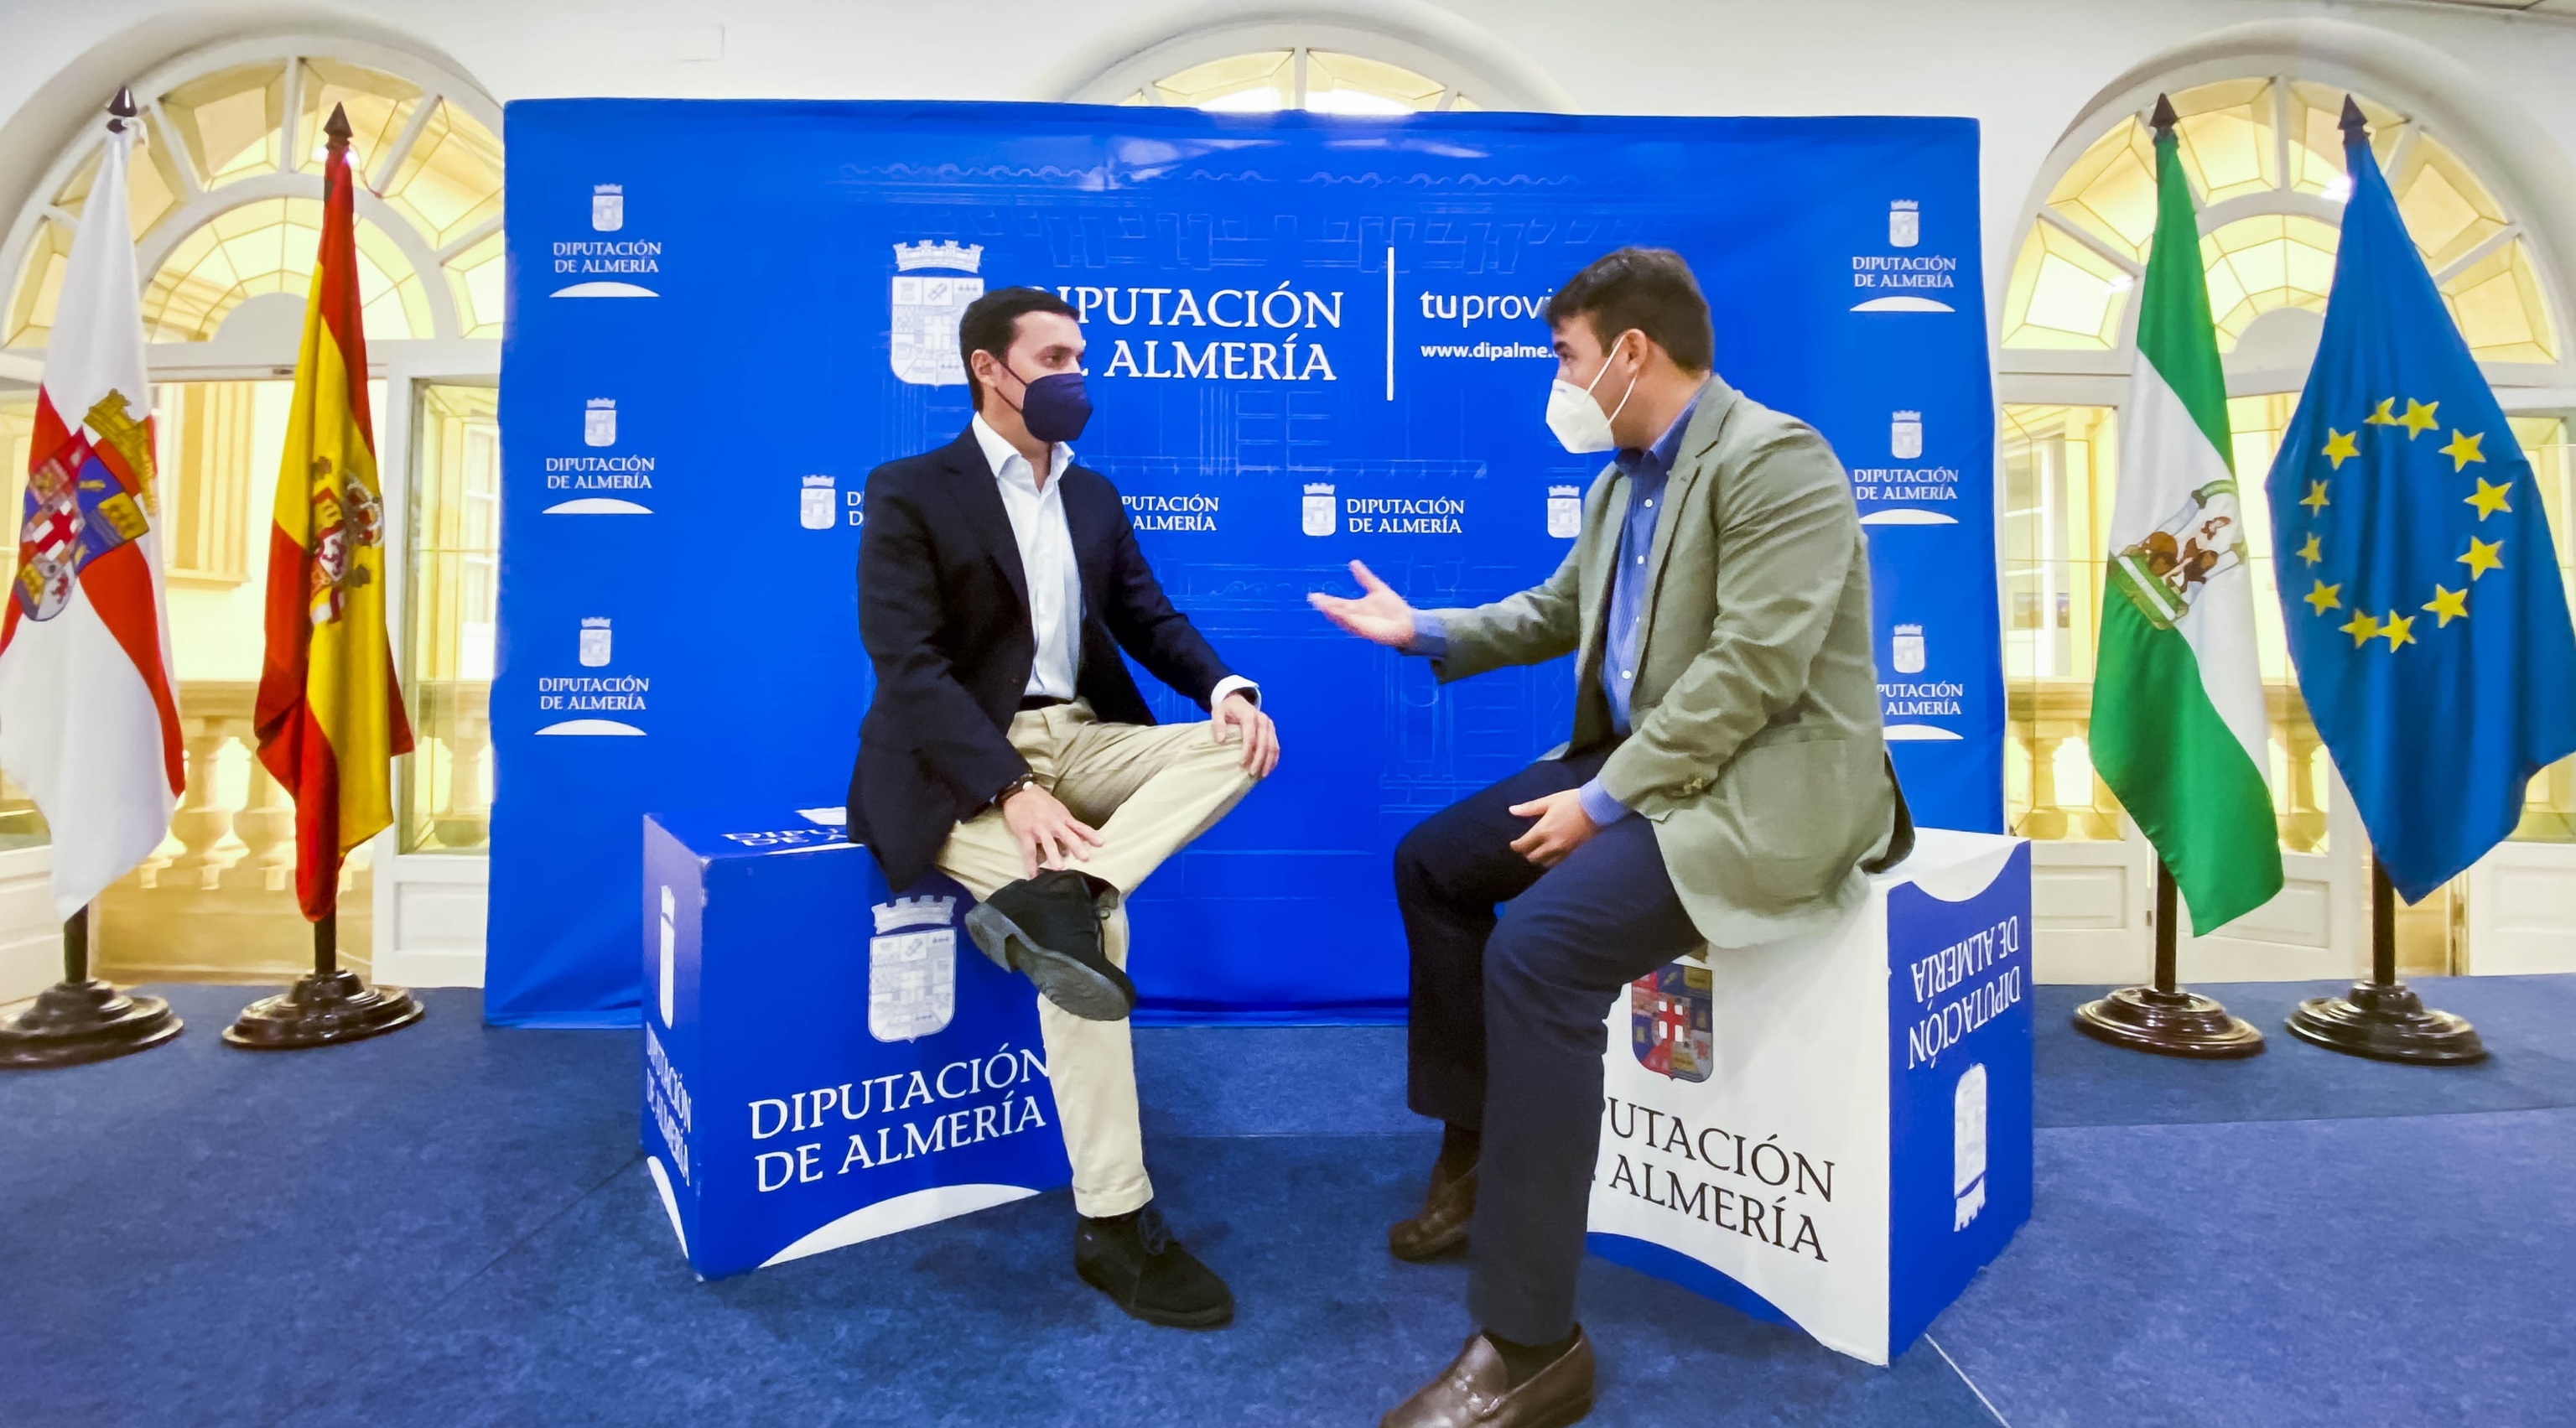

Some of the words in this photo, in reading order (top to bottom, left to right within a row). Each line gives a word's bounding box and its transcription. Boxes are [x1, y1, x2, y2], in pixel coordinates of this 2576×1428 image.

[553, 239, 662, 256] DIPUTACIÓN
[554, 259, 577, 273] DE
[582, 255, 659, 273] ALMERÍA
[1852, 255, 1956, 271] DIPUTACIÓN
[1854, 273, 1875, 288] DE
[1880, 272, 1955, 288] ALMERÍA
[1027, 281, 1344, 329] PUTACIÓN
[1104, 334, 1337, 381] ALMERÍA
[546, 454, 655, 471] DIPUTACIÓN
[548, 475, 569, 489] DE
[574, 473, 652, 490] ALMERÍA
[1854, 466, 1959, 484] DIPUTACIÓN
[1856, 486, 1878, 501] DE
[1883, 485, 1958, 501] ALMERÍA
[1121, 494, 1219, 512] PUTACIÓN
[1347, 496, 1464, 517] DIPUTACIÓN
[1133, 512, 1217, 531] ALMERÍA
[1348, 517, 1374, 533] DE
[1379, 515, 1462, 534] ALMERÍA
[539, 675, 649, 693] DIPUTACIÓN
[1877, 680, 1964, 698] PUTACIÓN
[541, 696, 563, 710] DE
[568, 693, 646, 710] ALMERÍA
[1885, 698, 1961, 715] ALMERÍA
[1998, 915, 2019, 958] DE
[1911, 927, 1995, 1010] ALMERÍA
[1909, 966, 2021, 1070] DIPUTACIÓN
[748, 1042, 1049, 1140] DIPUTACIÓN
[756, 1143, 823, 1192] DE
[838, 1090, 1046, 1175] ALMERÍA
[1607, 1097, 1835, 1202] UTACIÓN
[1608, 1154, 1829, 1262] ALMERÍA
